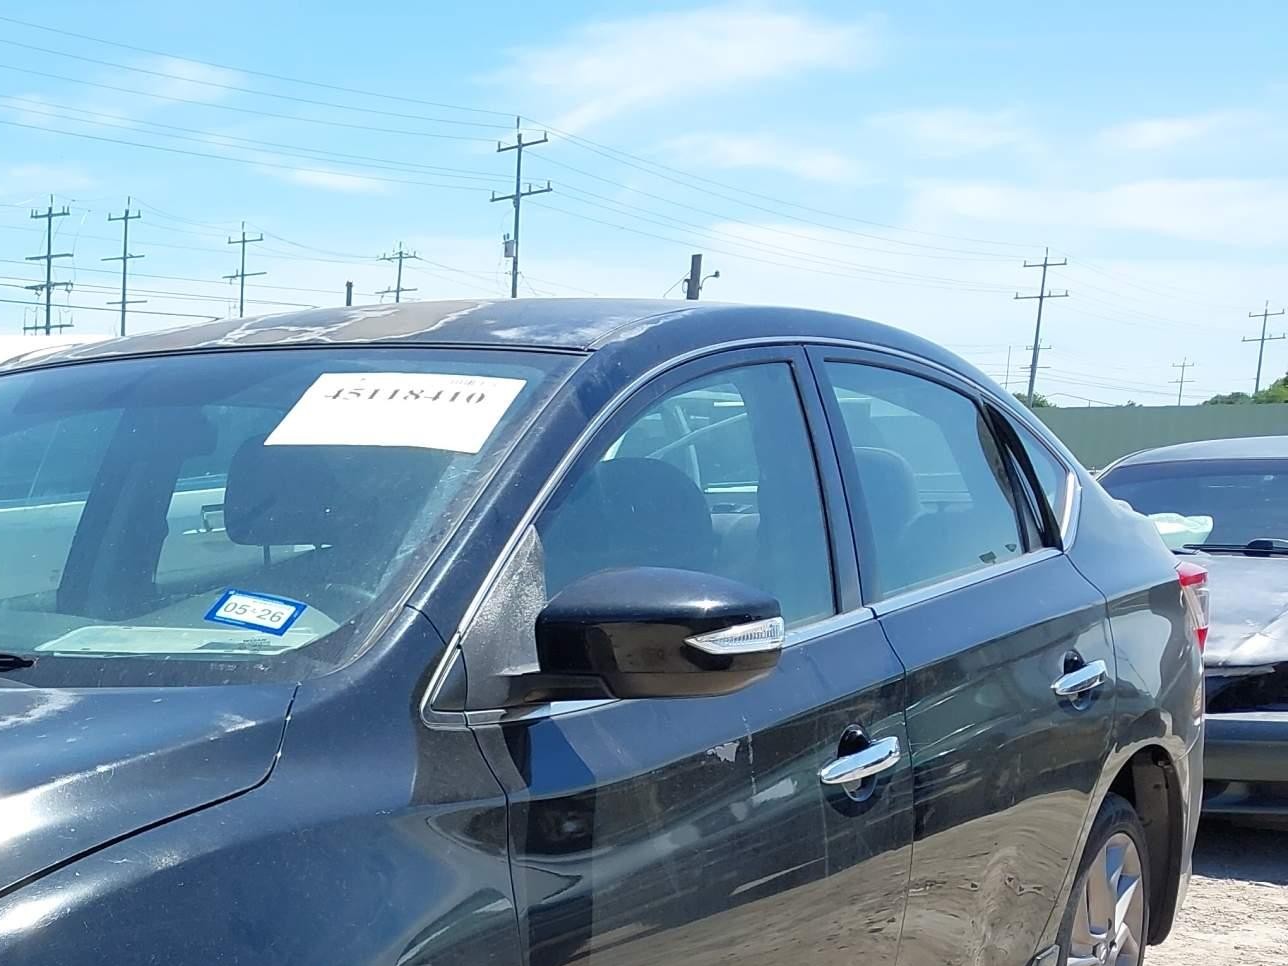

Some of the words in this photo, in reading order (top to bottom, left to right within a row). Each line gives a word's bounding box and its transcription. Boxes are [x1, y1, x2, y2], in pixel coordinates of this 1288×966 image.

[324, 387, 485, 404] 45118410
[223, 601, 249, 616] 05
[256, 608, 285, 623] 26
